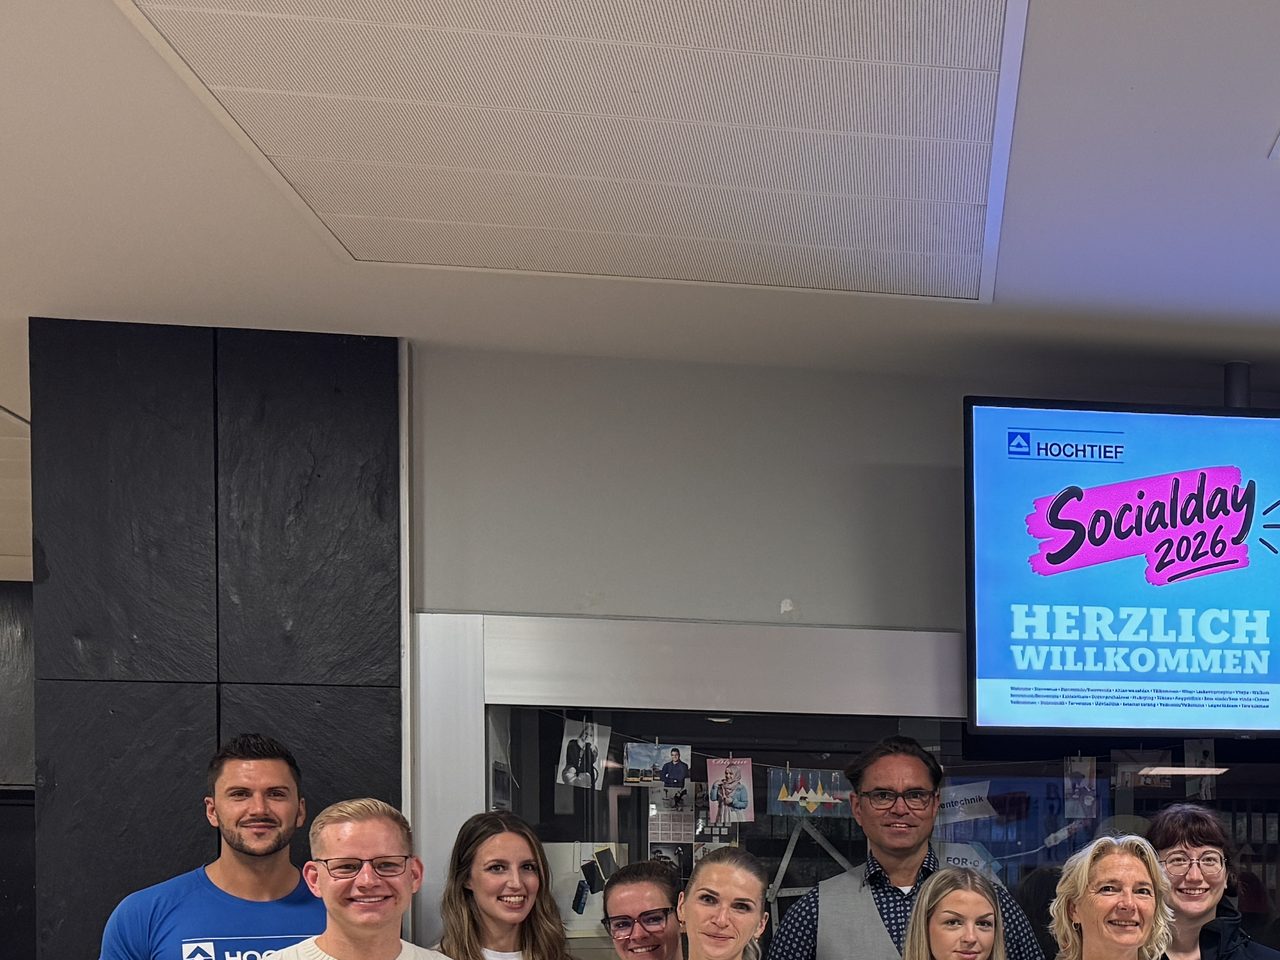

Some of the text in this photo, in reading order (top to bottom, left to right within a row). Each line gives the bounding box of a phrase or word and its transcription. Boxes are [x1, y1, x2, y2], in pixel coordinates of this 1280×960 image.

[1036, 441, 1125, 459] HOCHTIEF
[1045, 472, 1256, 565] Socialday
[1154, 525, 1227, 573] 2026
[1010, 603, 1271, 645] HERZLICH
[1009, 645, 1271, 674] WILLKOMMEN
[940, 795, 984, 809] entechnik
